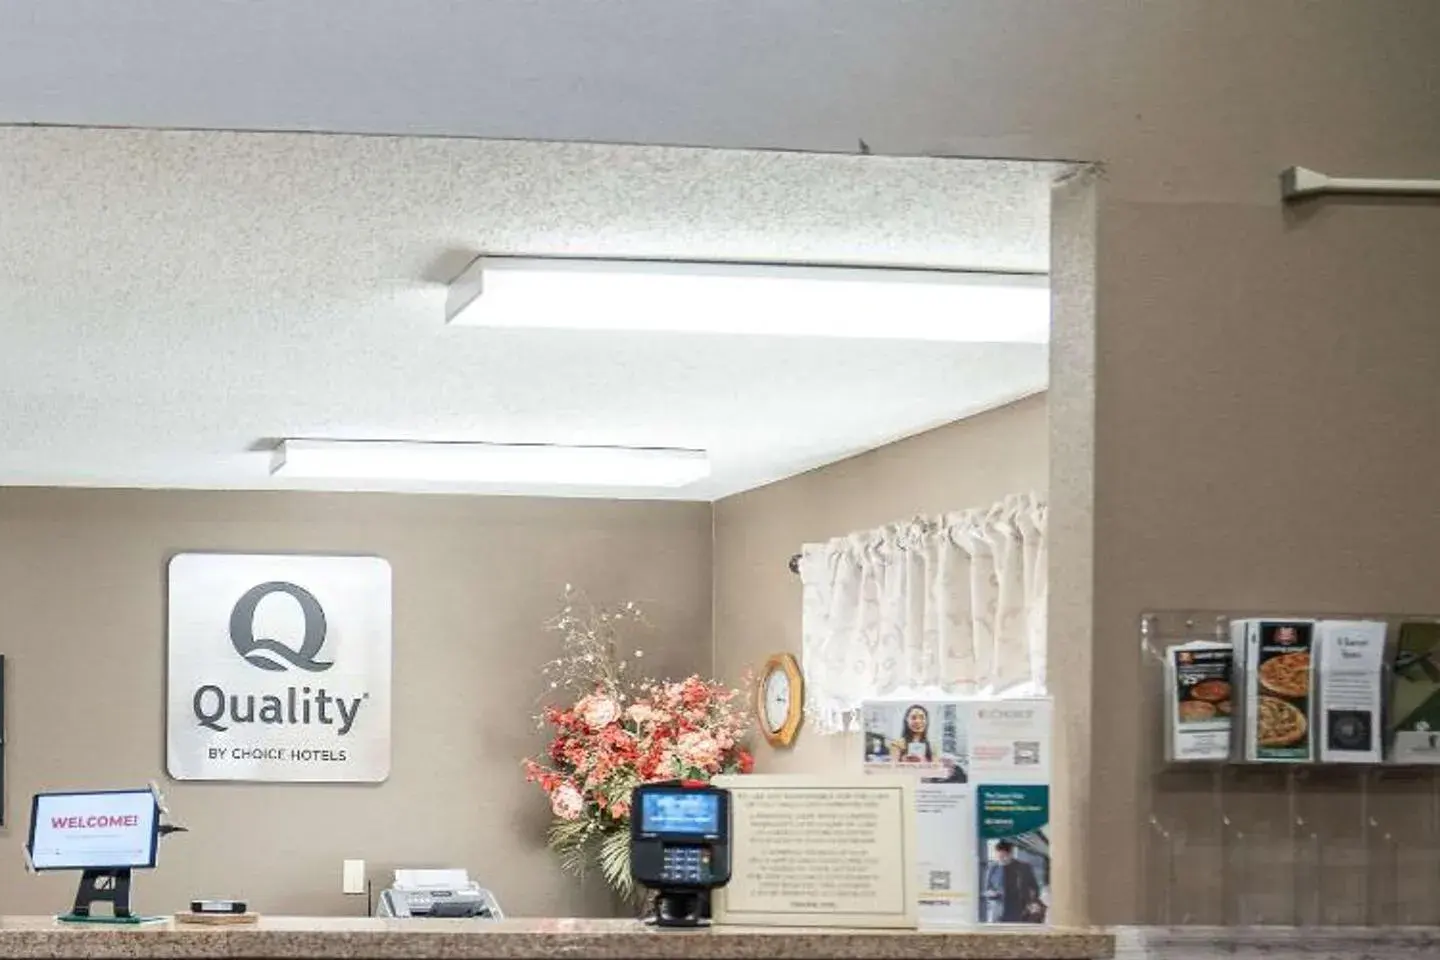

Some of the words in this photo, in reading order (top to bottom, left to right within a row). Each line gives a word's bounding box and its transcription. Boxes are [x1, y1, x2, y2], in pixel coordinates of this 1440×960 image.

[229, 581, 335, 672] Q
[193, 684, 362, 736] Quality
[208, 748, 227, 760] BY
[231, 748, 285, 761] CHOICE
[290, 749, 347, 762] HOTELS
[50, 815, 139, 829] WELCOME!
